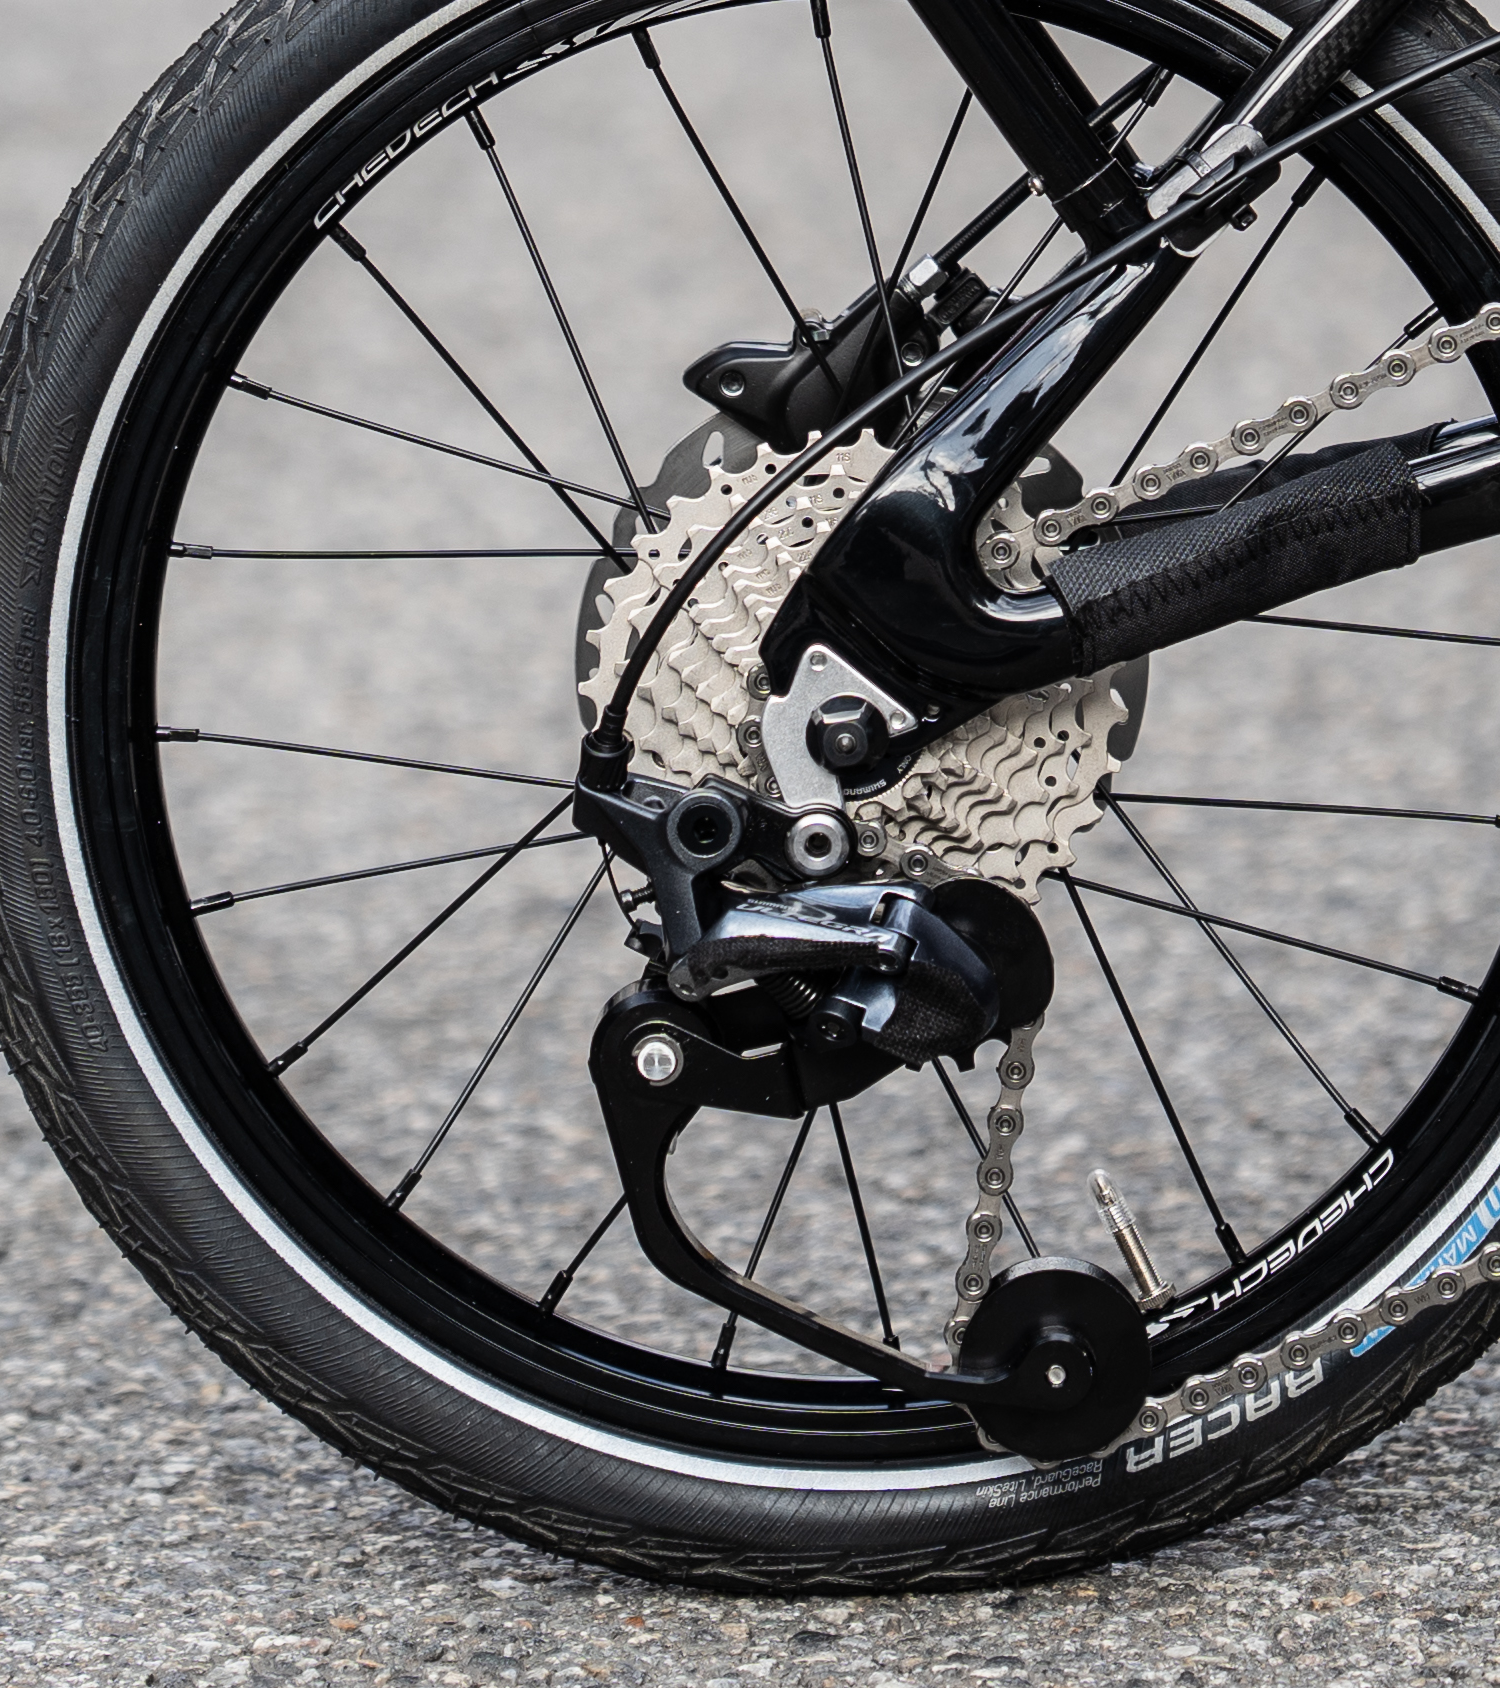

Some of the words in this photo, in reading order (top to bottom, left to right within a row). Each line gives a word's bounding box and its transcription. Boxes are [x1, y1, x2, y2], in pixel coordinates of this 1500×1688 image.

[313, 71, 500, 230] CHEDECH
[1211, 1148, 1394, 1311] CHEDECH
[1125, 1356, 1325, 1474] RACER
[975, 1478, 1027, 1498] LiteSkin
[988, 1494, 1016, 1508] Line
[1019, 1473, 1102, 1504] Performance
